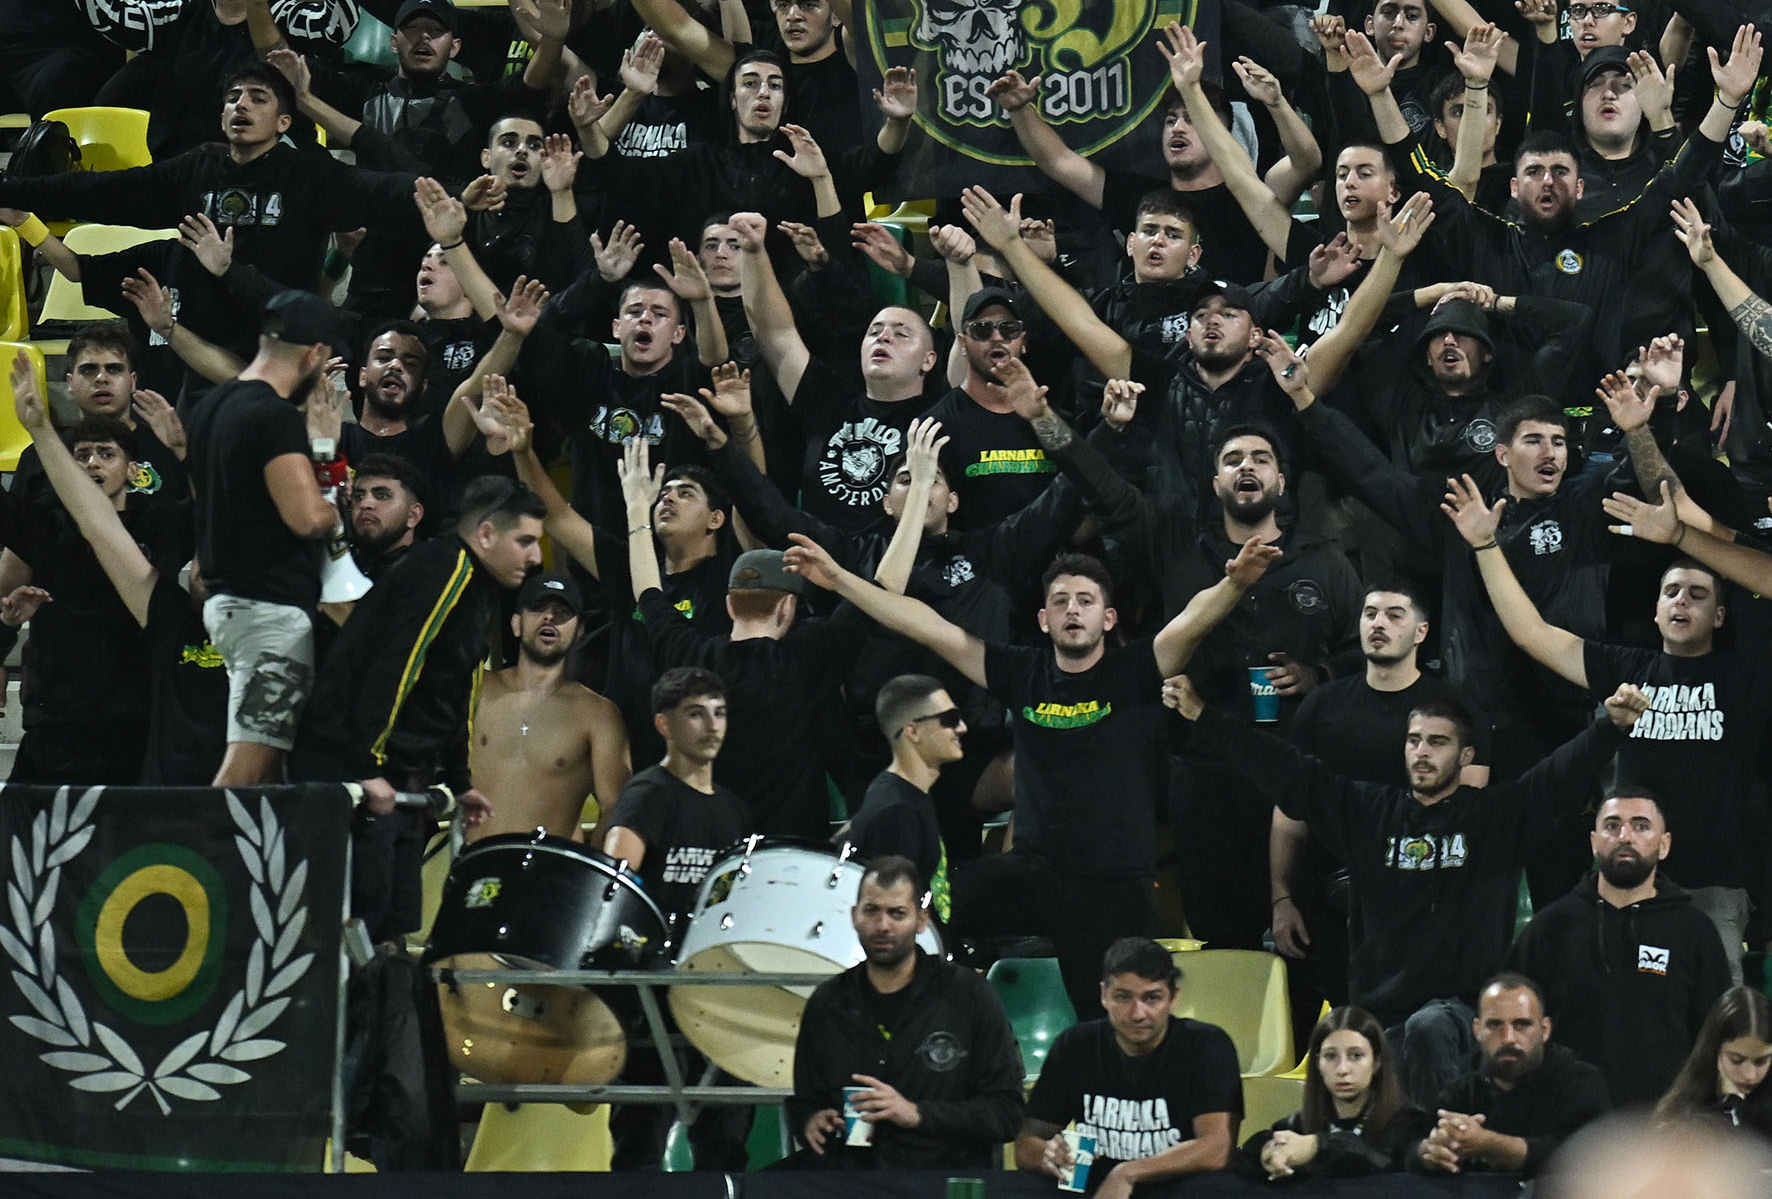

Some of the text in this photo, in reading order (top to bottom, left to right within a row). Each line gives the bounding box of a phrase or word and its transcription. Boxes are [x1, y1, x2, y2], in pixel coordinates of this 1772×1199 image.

[1044, 65, 1124, 117] 2011
[980, 449, 1046, 463] LARNAKA
[819, 461, 889, 507] AMSTERD
[1083, 1093, 1170, 1132] LARNAKA
